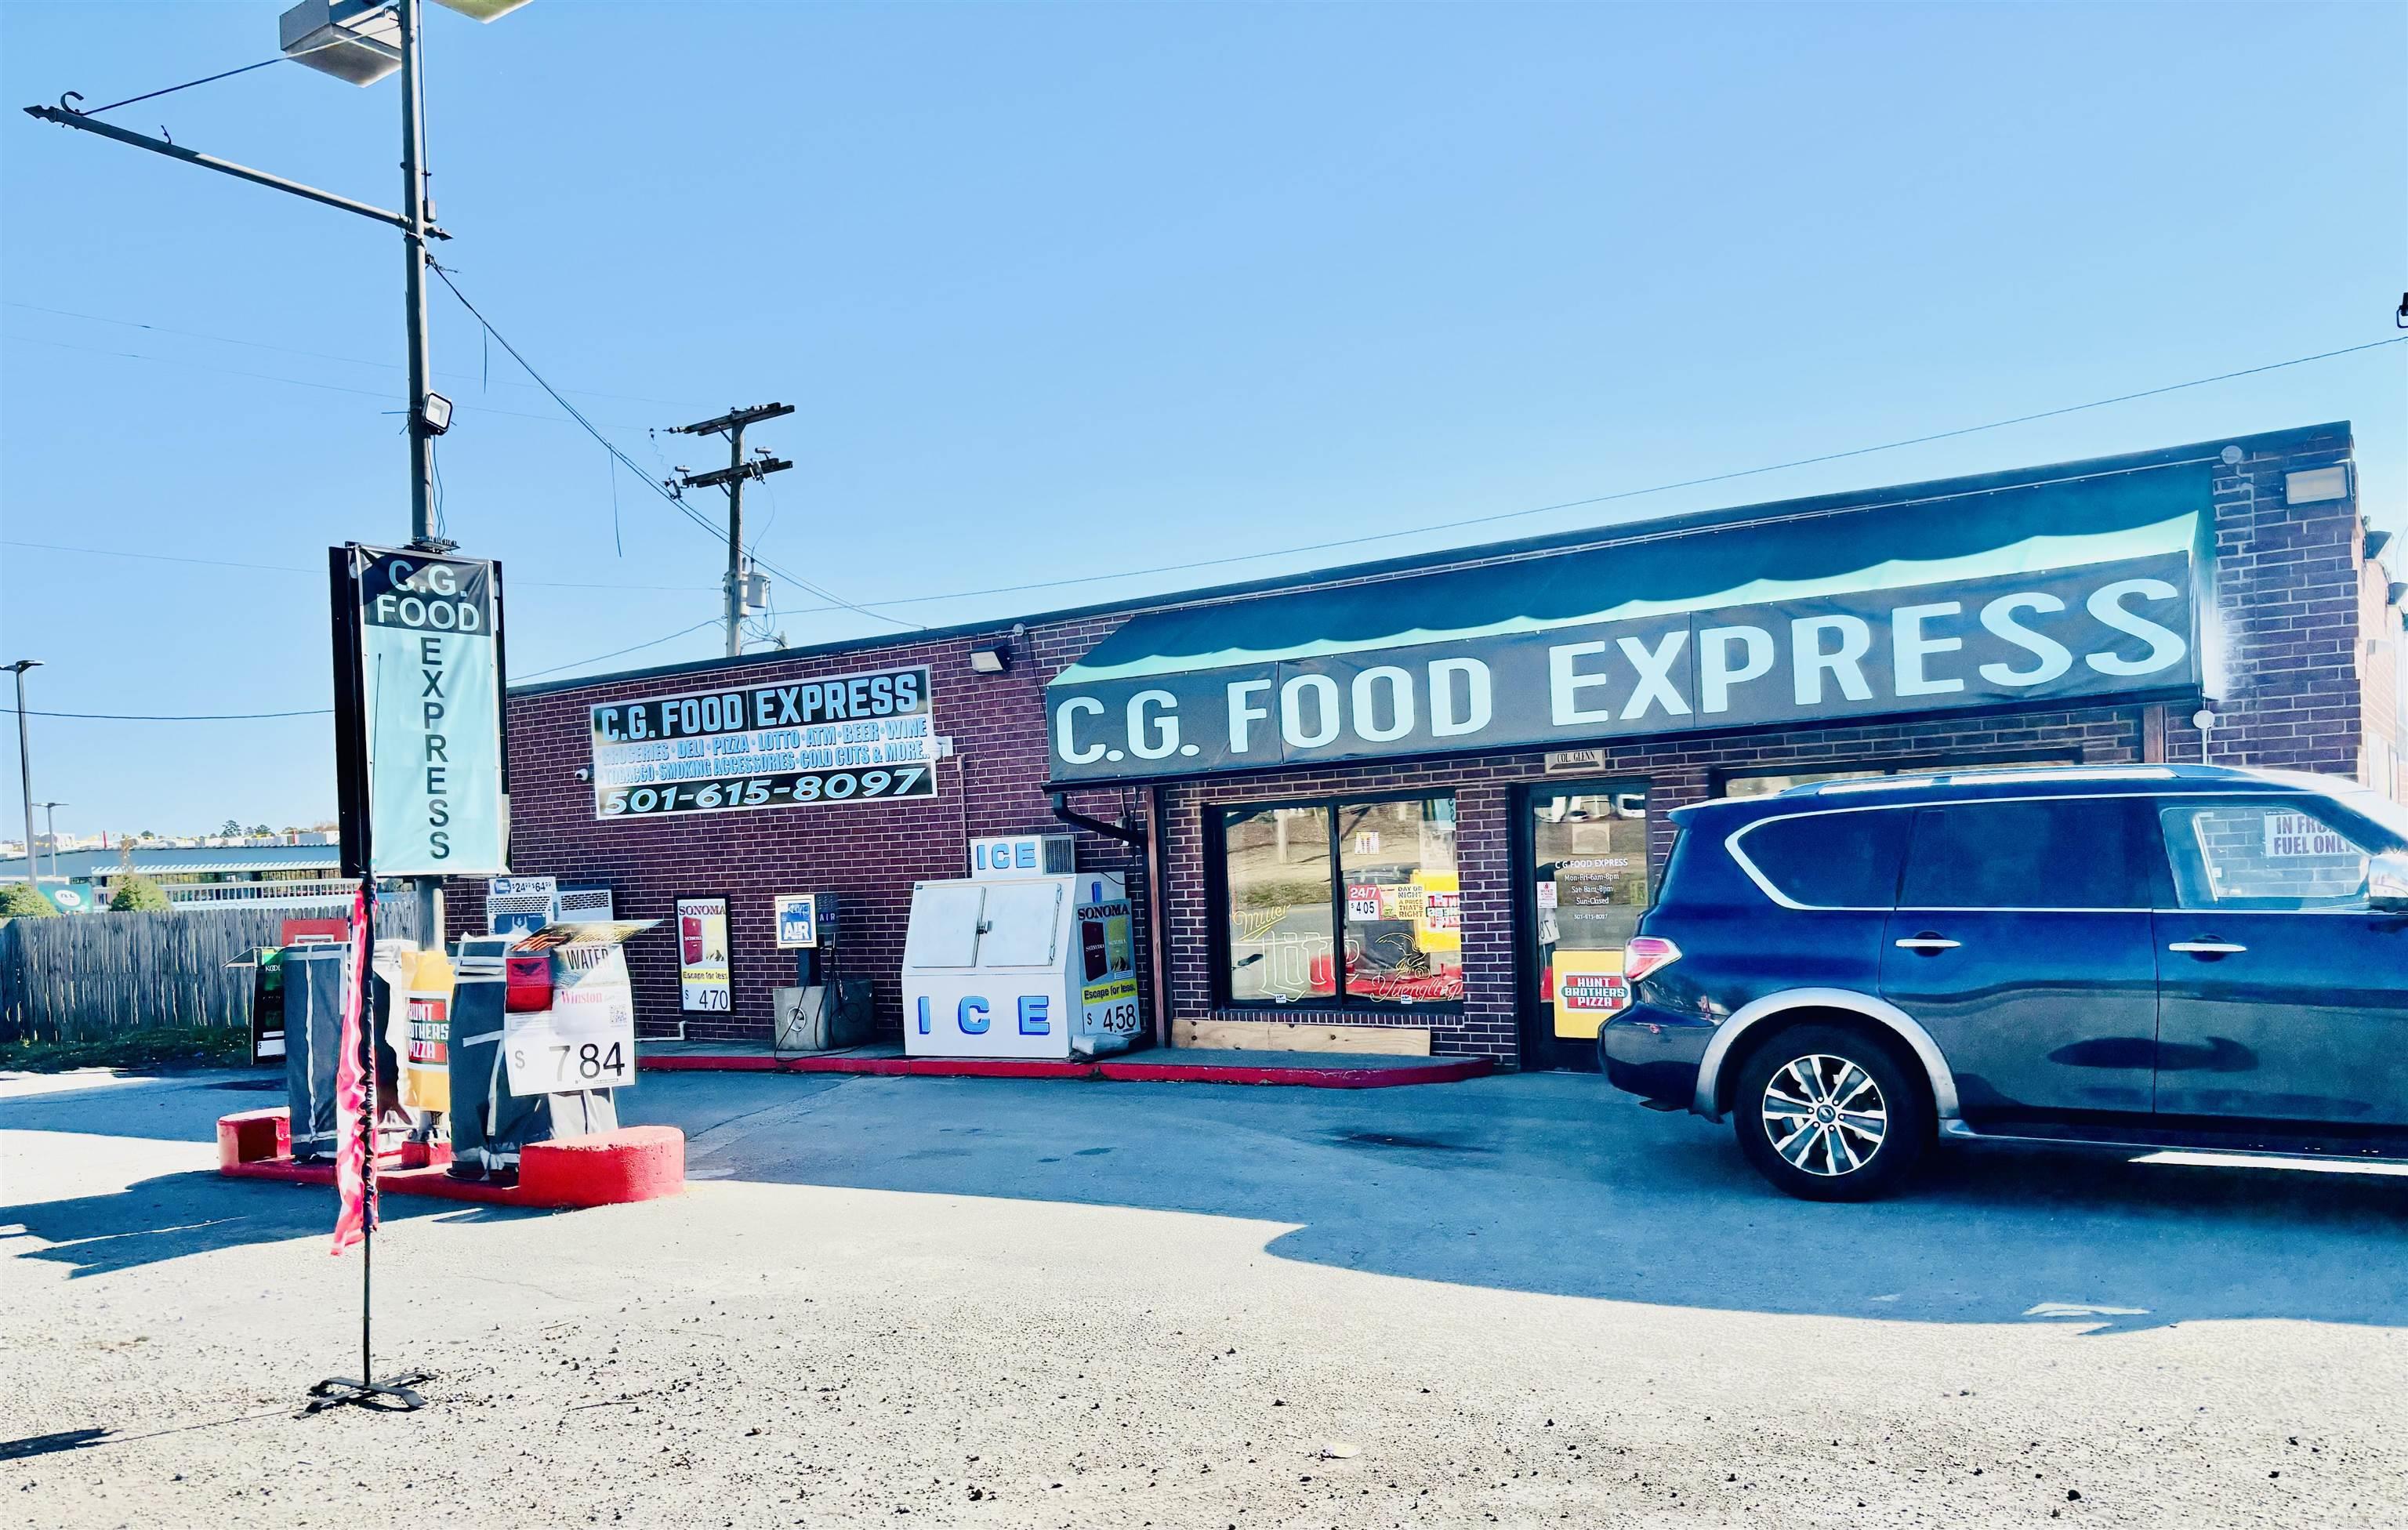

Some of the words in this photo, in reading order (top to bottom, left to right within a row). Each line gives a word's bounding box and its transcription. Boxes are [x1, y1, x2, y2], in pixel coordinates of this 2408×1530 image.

[389, 560, 467, 596] C.G.
[377, 593, 480, 631] FOOD
[1056, 690, 1200, 765] C.G.
[1227, 657, 1492, 753] FOOD
[1549, 578, 2187, 727] EXPRESS
[602, 705, 656, 741] C.G.
[662, 694, 742, 734] FOOD
[756, 673, 918, 727] EXPRESS
[676, 739, 705, 759] DELI
[712, 734, 749, 756] PIZZA
[758, 729, 800, 752] LOTTO
[806, 726, 836, 747] ATM
[843, 722, 879, 744] BEER
[886, 717, 927, 740] WINE
[420, 637, 451, 860] EXPRESS
[1557, 753, 1571, 763] COL.
[1573, 751, 1595, 762] GLENN
[604, 764, 655, 785] TOBACCO
[658, 758, 712, 781] SMOKING
[714, 752, 795, 776] ACCESSORIES
[800, 748, 832, 769] COLD
[835, 745, 869, 766] CUTS
[873, 745, 883, 763] &
[604, 767, 927, 814] 501-615-8097
[2276, 816, 2293, 834] IN
[2274, 836, 2309, 854] FUEL
[977, 842, 1036, 870] ICE
[1595, 858, 1628, 867] EXPRESS
[1350, 886, 1377, 898] 24/7
[679, 905, 726, 915] SONOMA
[819, 913, 836, 922] AIR
[1078, 904, 1130, 920] SONOMA
[784, 921, 811, 940] AIR
[1370, 972, 1461, 1002] Yuengling
[1577, 977, 1611, 987] HUNT
[561, 991, 602, 1004] Winston
[685, 989, 689, 1000] $
[1084, 988, 1109, 1000] Escape
[1110, 985, 1120, 995] for
[1565, 988, 1625, 997] BROTHERS
[1578, 997, 1612, 1006] PIZZA
[918, 995, 1050, 1035] ICE
[1087, 1012, 1093, 1025] $
[514, 1050, 525, 1070] $
